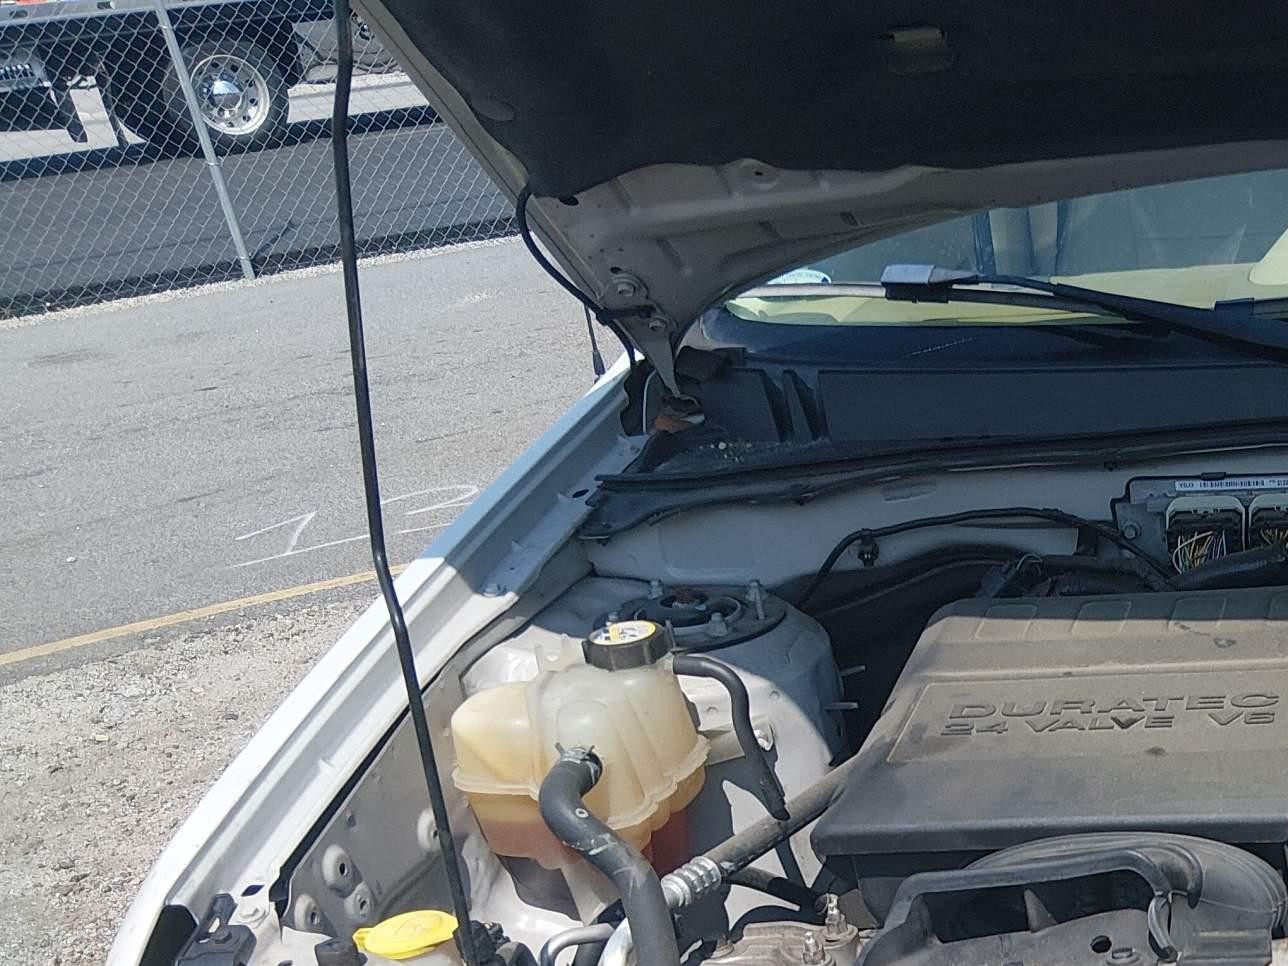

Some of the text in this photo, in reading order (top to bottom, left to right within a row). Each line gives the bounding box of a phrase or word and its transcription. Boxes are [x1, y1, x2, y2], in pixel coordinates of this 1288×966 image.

[948, 693, 1280, 720] DURATEC
[941, 711, 1276, 736] 24 VALVE V6
